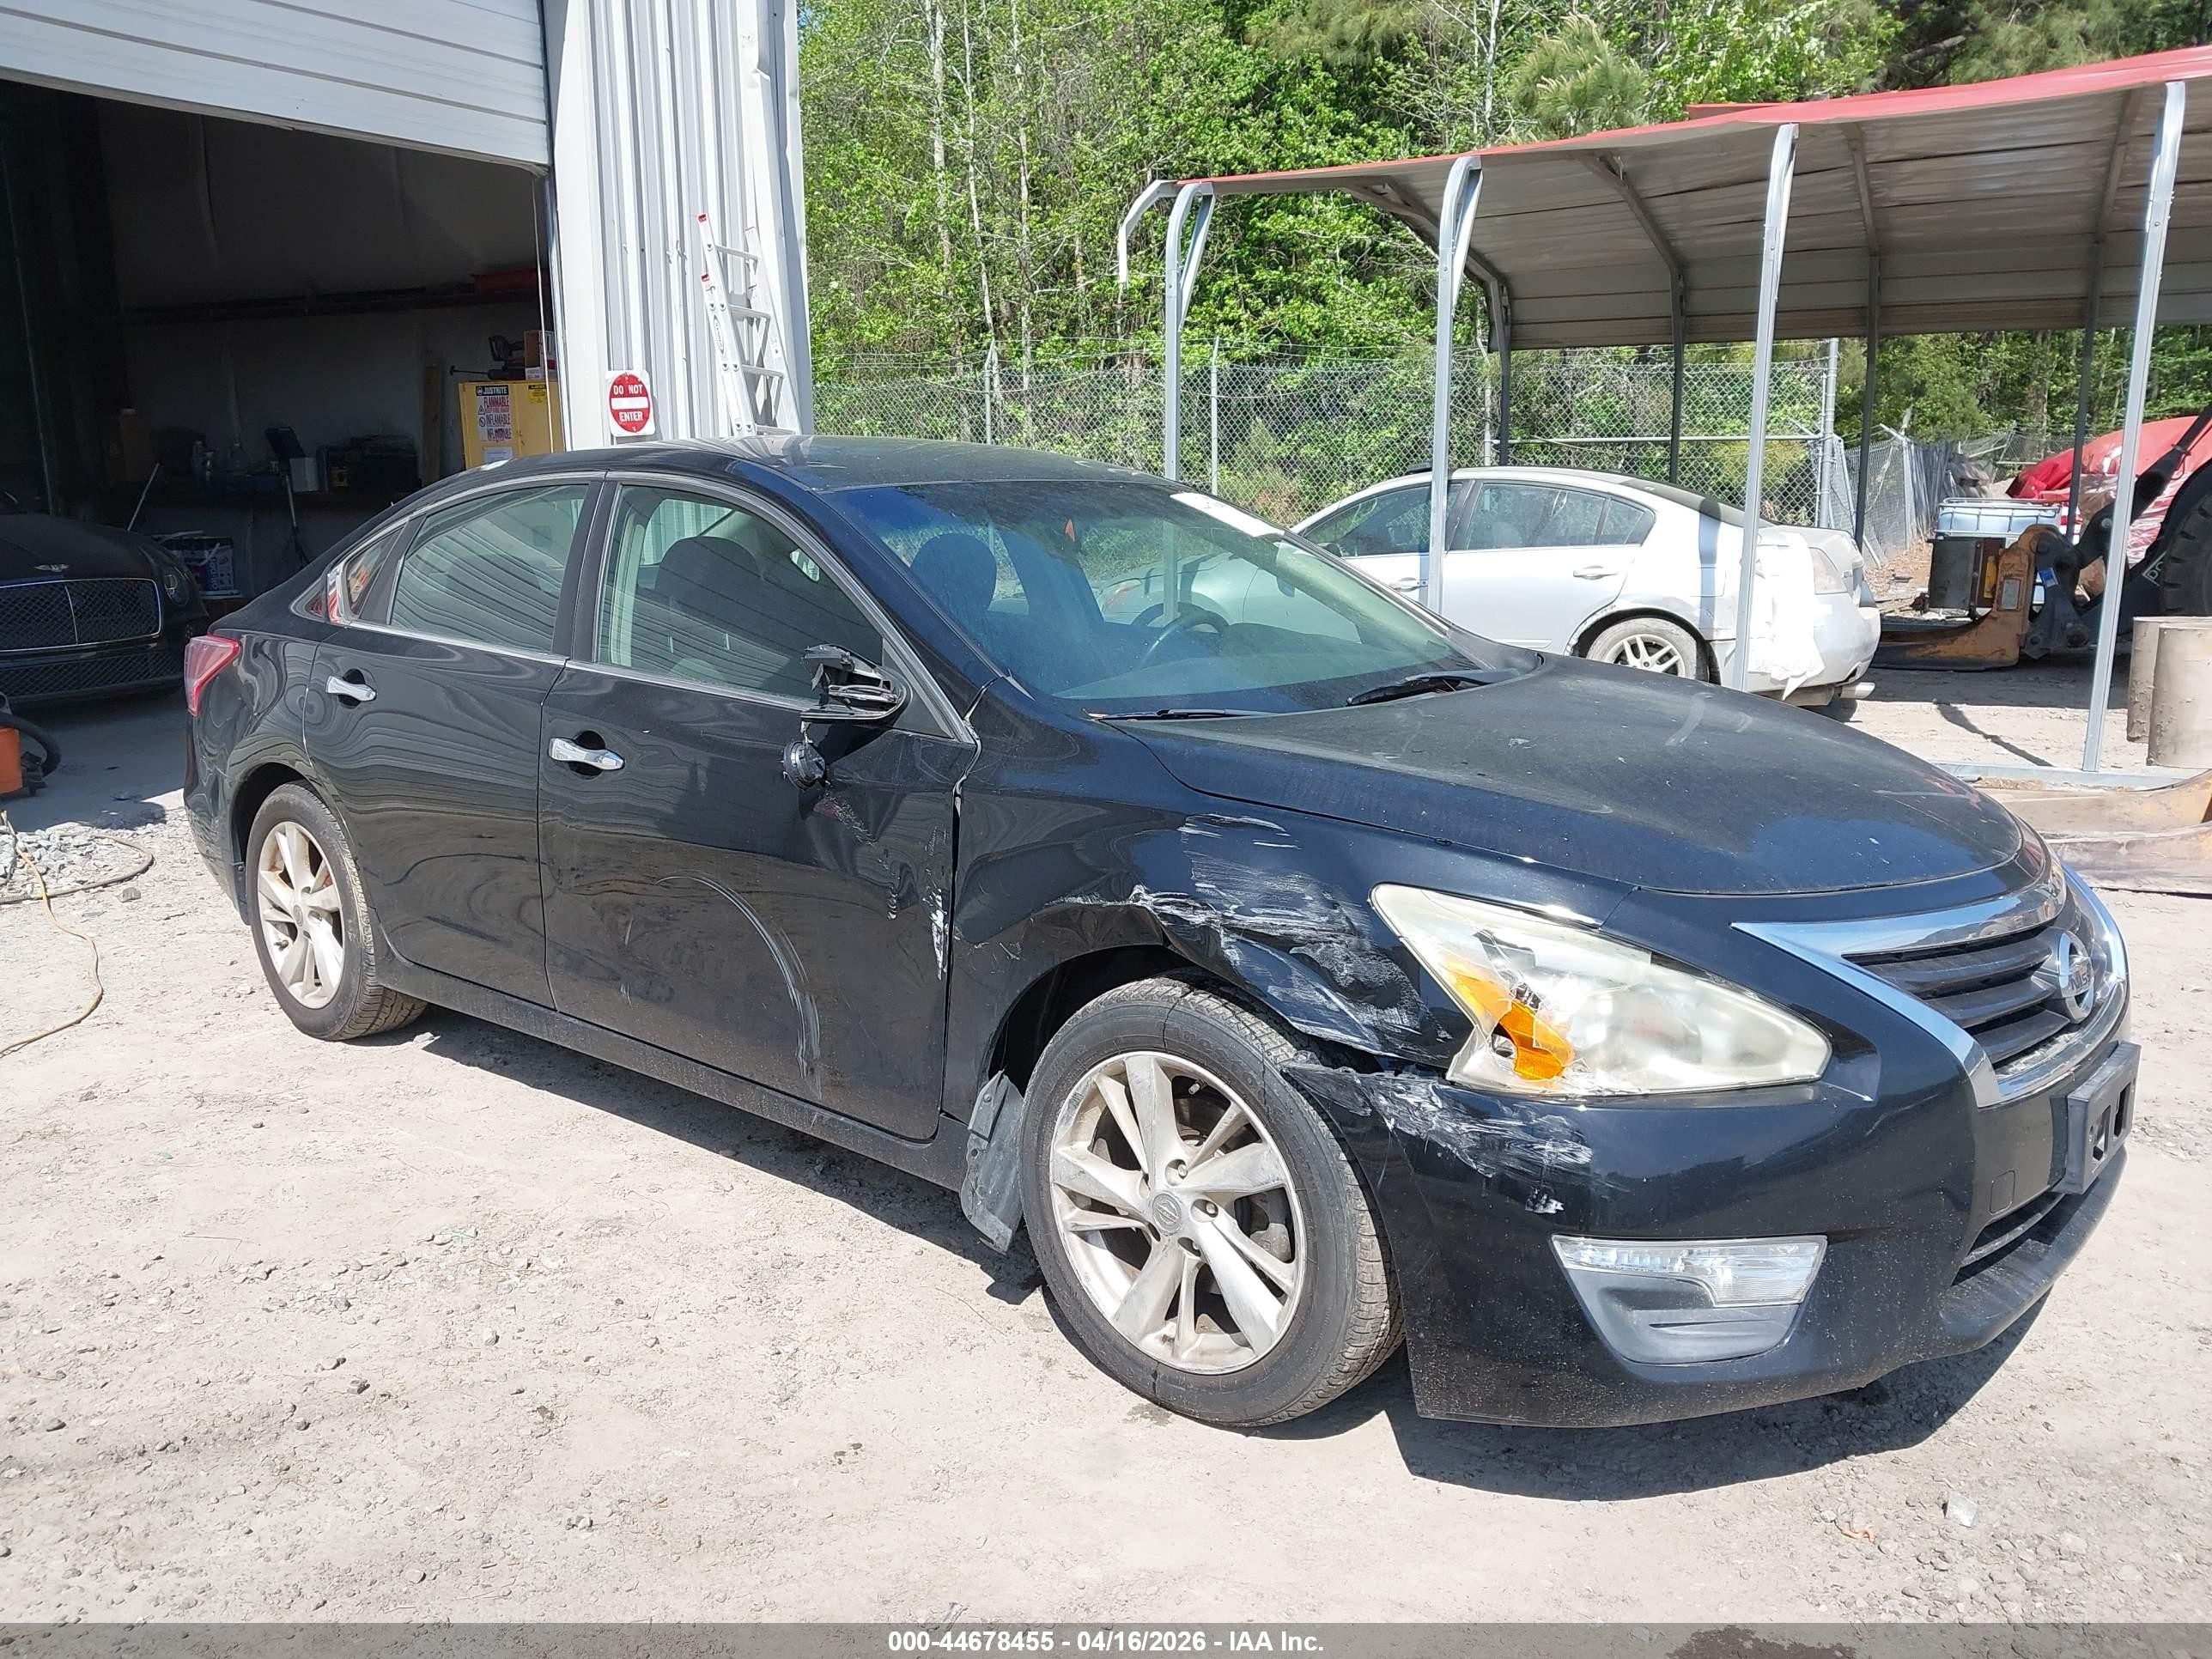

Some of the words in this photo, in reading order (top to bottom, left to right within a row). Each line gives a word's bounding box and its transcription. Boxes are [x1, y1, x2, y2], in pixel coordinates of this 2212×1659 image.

[613, 385, 624, 395] DO
[628, 384, 643, 394] NOT
[483, 396, 509, 407] FLAMMABLE
[619, 411, 643, 422] ENTER
